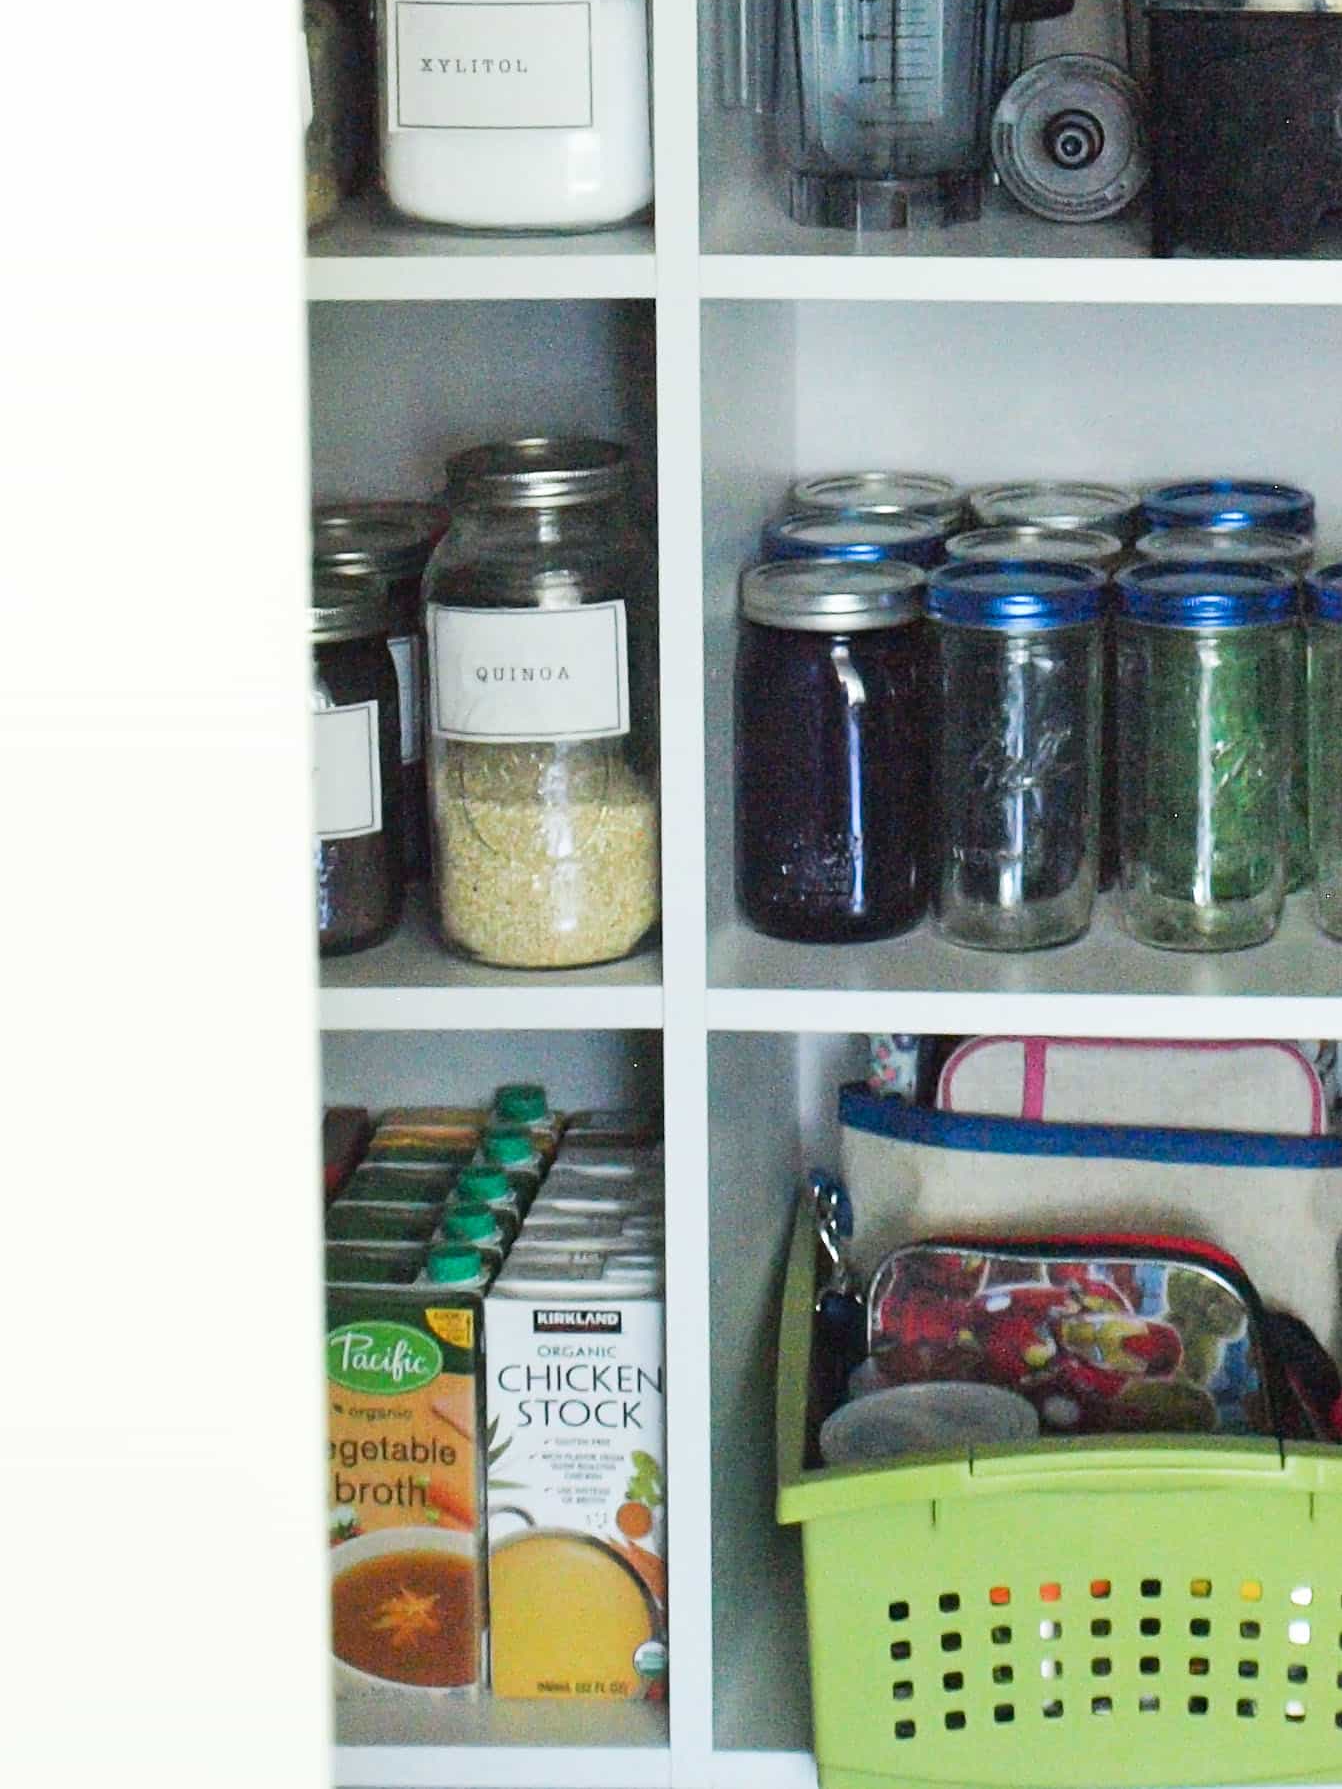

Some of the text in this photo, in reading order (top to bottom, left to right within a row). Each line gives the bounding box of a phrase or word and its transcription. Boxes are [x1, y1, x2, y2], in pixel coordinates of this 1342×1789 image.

[419, 57, 529, 74] XYLITOL
[475, 666, 571, 683] QUINOA
[536, 1311, 619, 1326] KIRKLAND
[329, 1331, 428, 1381] Pacific
[536, 1344, 617, 1360] ORGANIC
[497, 1363, 664, 1395] CHICKEN
[517, 1398, 644, 1430] STOCK
[335, 1472, 427, 1508] broth
